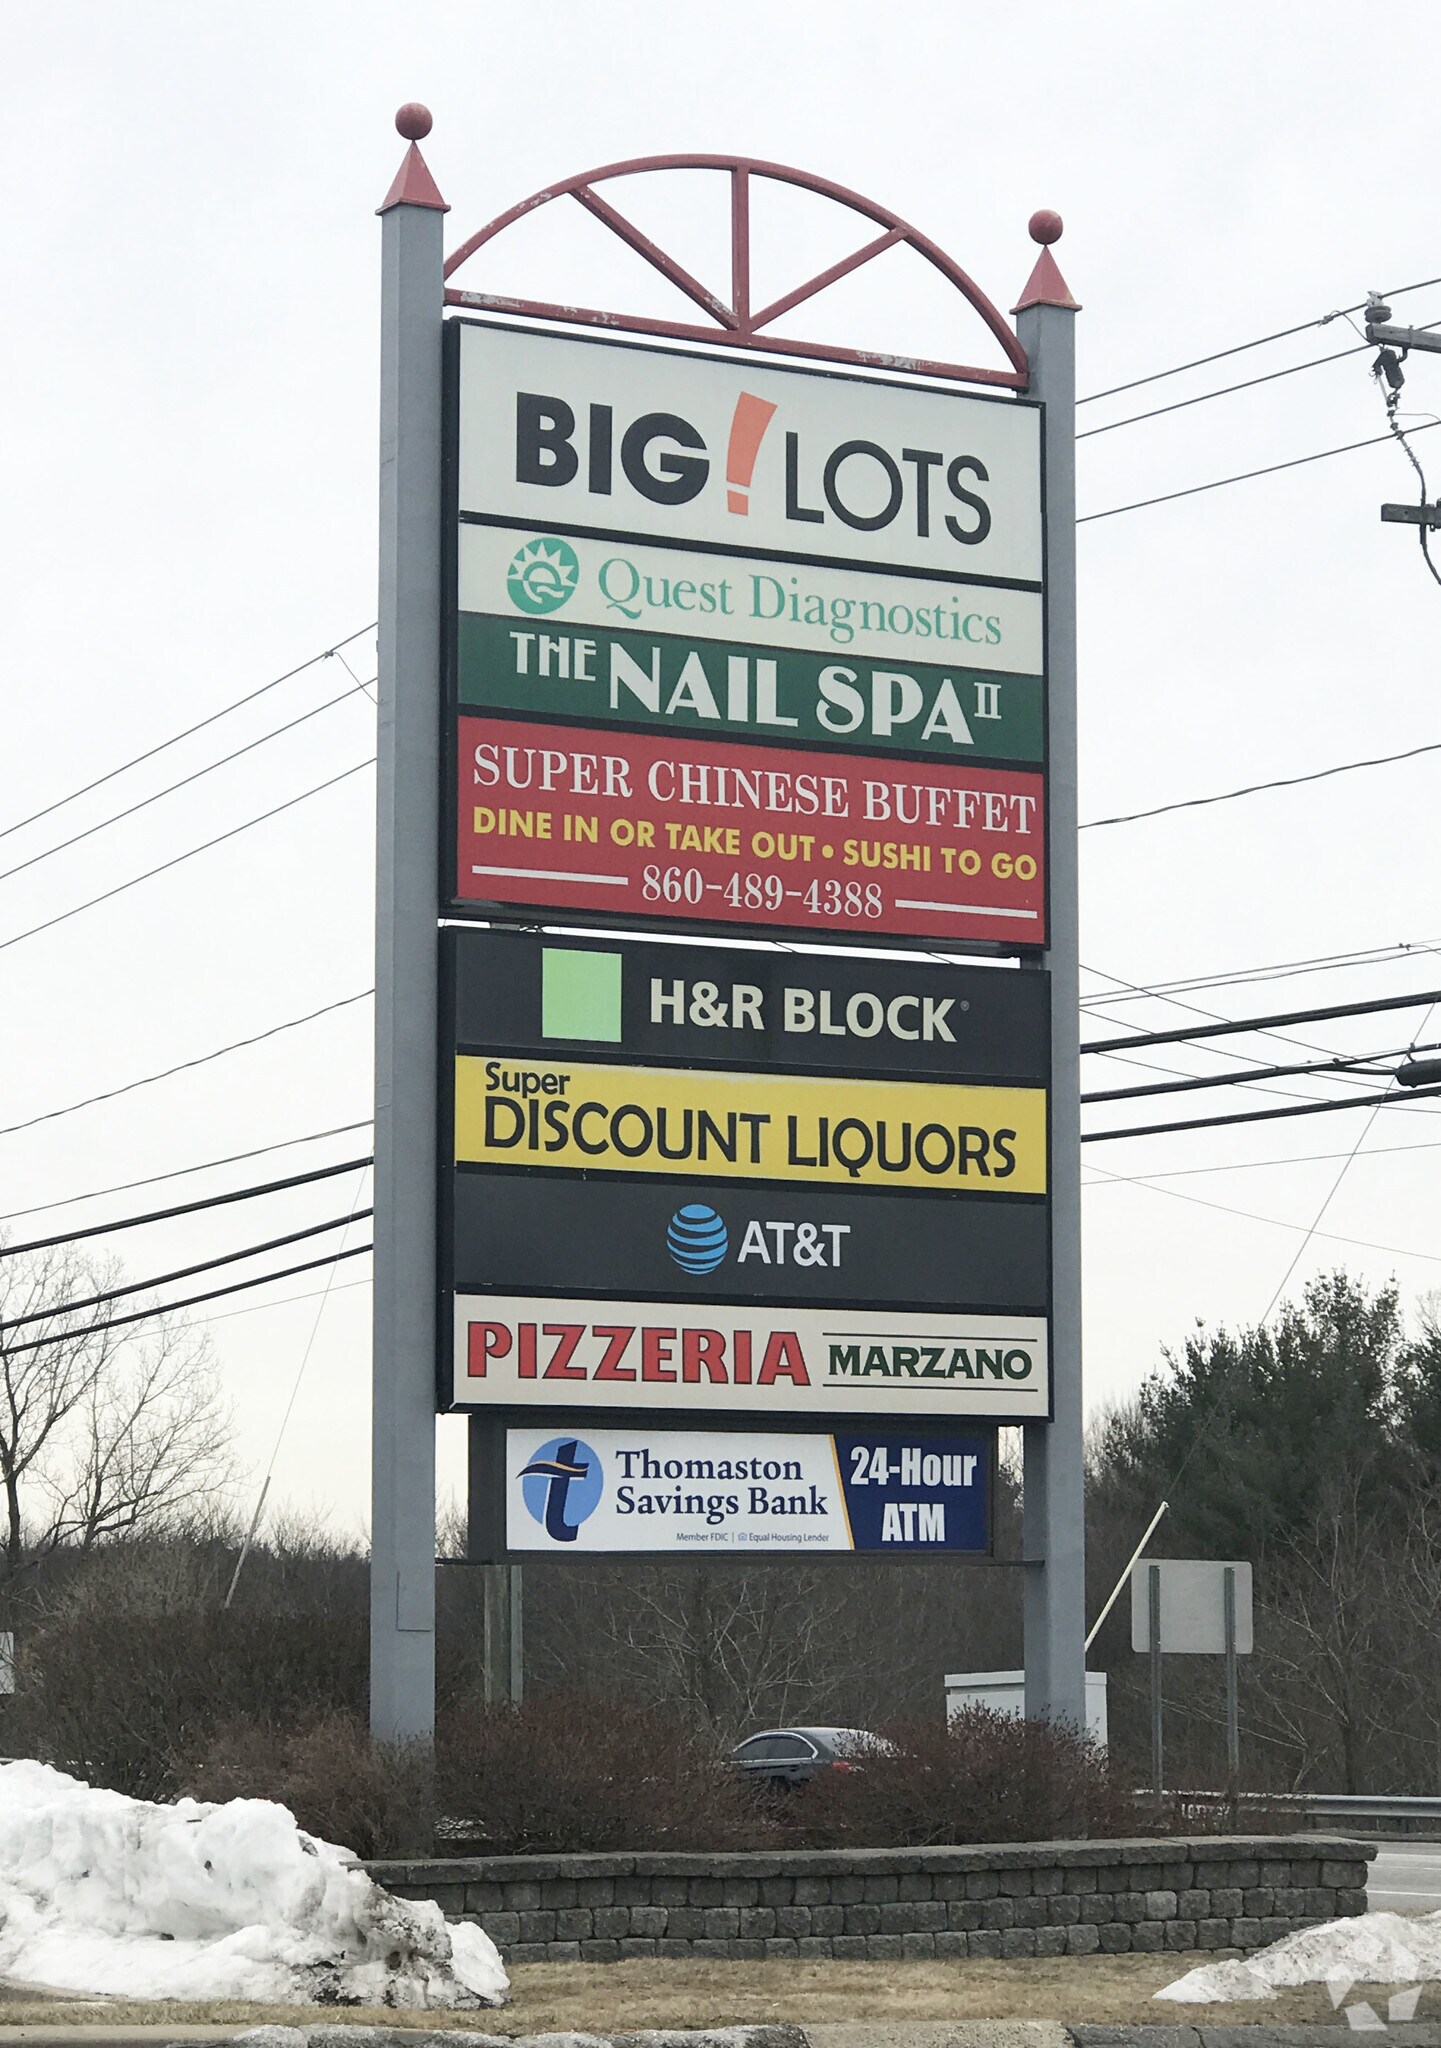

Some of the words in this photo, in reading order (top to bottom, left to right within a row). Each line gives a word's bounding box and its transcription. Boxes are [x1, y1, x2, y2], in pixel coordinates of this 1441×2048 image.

[786, 432, 991, 545] LOTS
[598, 558, 733, 620] Quest
[749, 576, 1001, 645] Diagnostics
[510, 631, 596, 681] THE
[610, 642, 798, 727] NAIL
[816, 665, 974, 745] SPA
[974, 683, 1001, 720] II
[473, 744, 632, 798] SUPER
[649, 761, 848, 818] CHINESE
[863, 781, 1036, 834] BUFFET
[473, 807, 552, 840] DINE
[564, 817, 598, 843] IN
[610, 819, 655, 848] OR
[665, 823, 740, 855] TAKE
[752, 832, 816, 861] OUT
[844, 840, 931, 872] SUSHI
[941, 847, 980, 876] TO
[991, 852, 1037, 881] GO
[642, 865, 883, 918] 860-489-4388
[651, 978, 765, 1030] H&R
[485, 1062, 570, 1097] Super
[485, 1096, 770, 1163] DISCOUNT
[788, 1115, 1016, 1177] LIQUORS
[737, 1221, 850, 1267] AT&T
[468, 1321, 810, 1386] PIZZERIA
[829, 1344, 1032, 1379] MARZANO
[616, 1450, 802, 1481] Thomaston
[850, 1447, 977, 1486] 24-Hour
[616, 1486, 739, 1524] Savings
[748, 1485, 828, 1515] Bank
[882, 1504, 946, 1542] ATM
[677, 1533, 708, 1541] Member
[711, 1533, 728, 1541] FDIC
[749, 1533, 769, 1542] Equal
[771, 1533, 802, 1542] Housing
